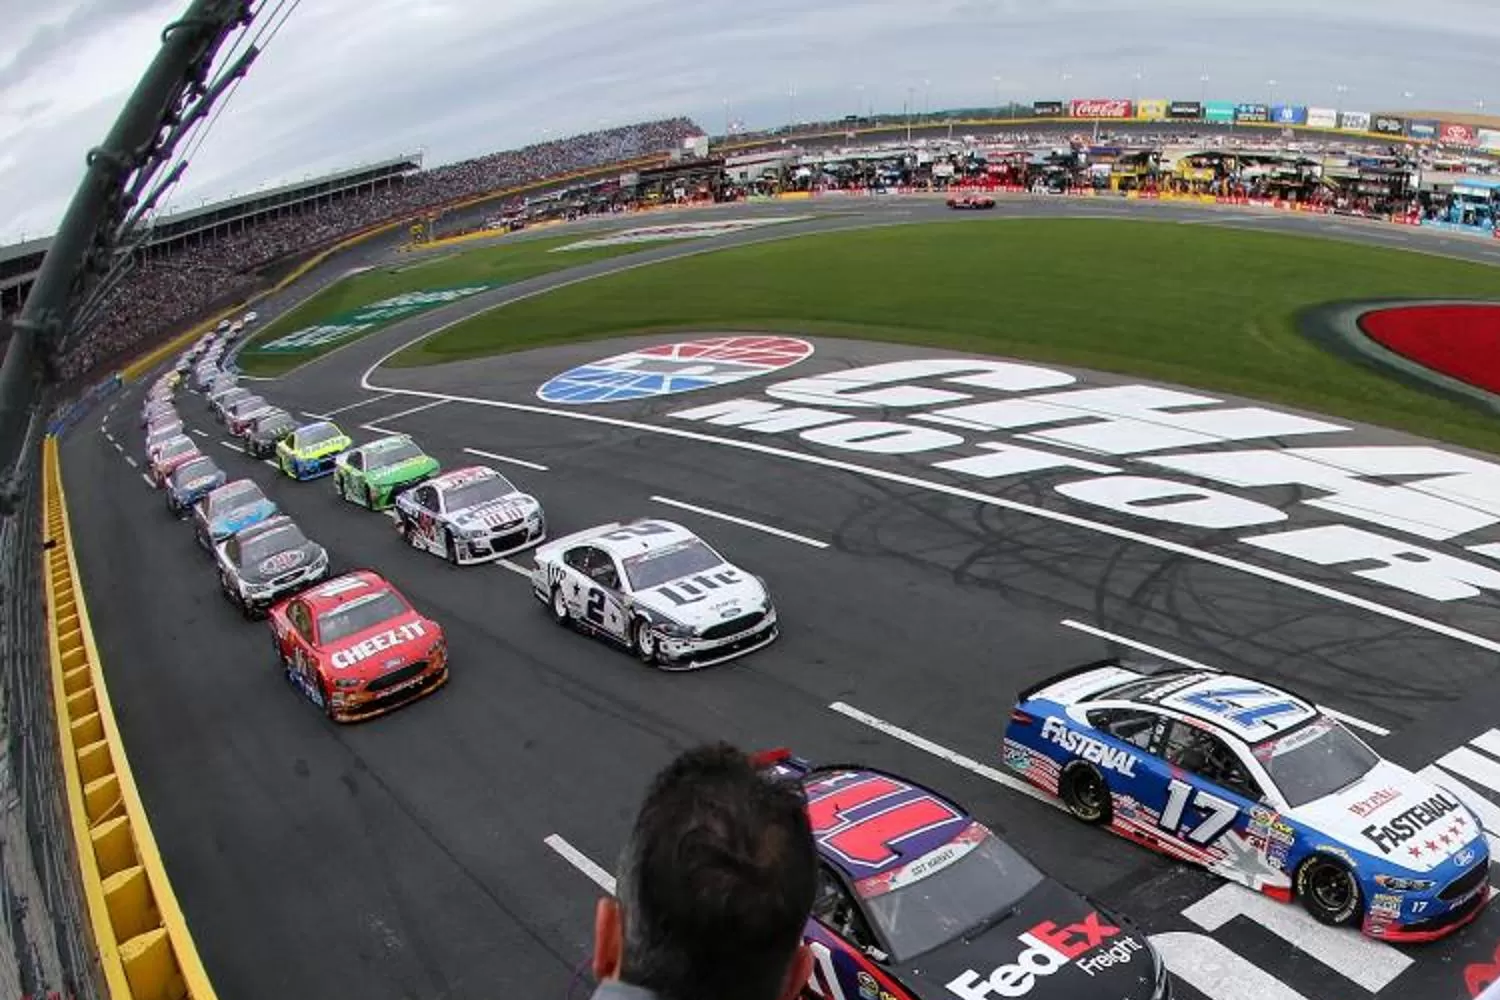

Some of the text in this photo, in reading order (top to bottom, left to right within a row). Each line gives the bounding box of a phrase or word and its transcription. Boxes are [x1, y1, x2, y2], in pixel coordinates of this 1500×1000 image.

[1075, 100, 1126, 118] Coca-Cola
[587, 587, 607, 625] 2
[655, 568, 743, 607] Lite
[331, 620, 427, 669] CHEEZ-IT
[1039, 715, 1139, 778] FASTENAL
[1158, 778, 1241, 847] 17
[1361, 791, 1460, 854] FASTENAL
[1410, 900, 1429, 914] 17
[1075, 935, 1144, 978] Freight
